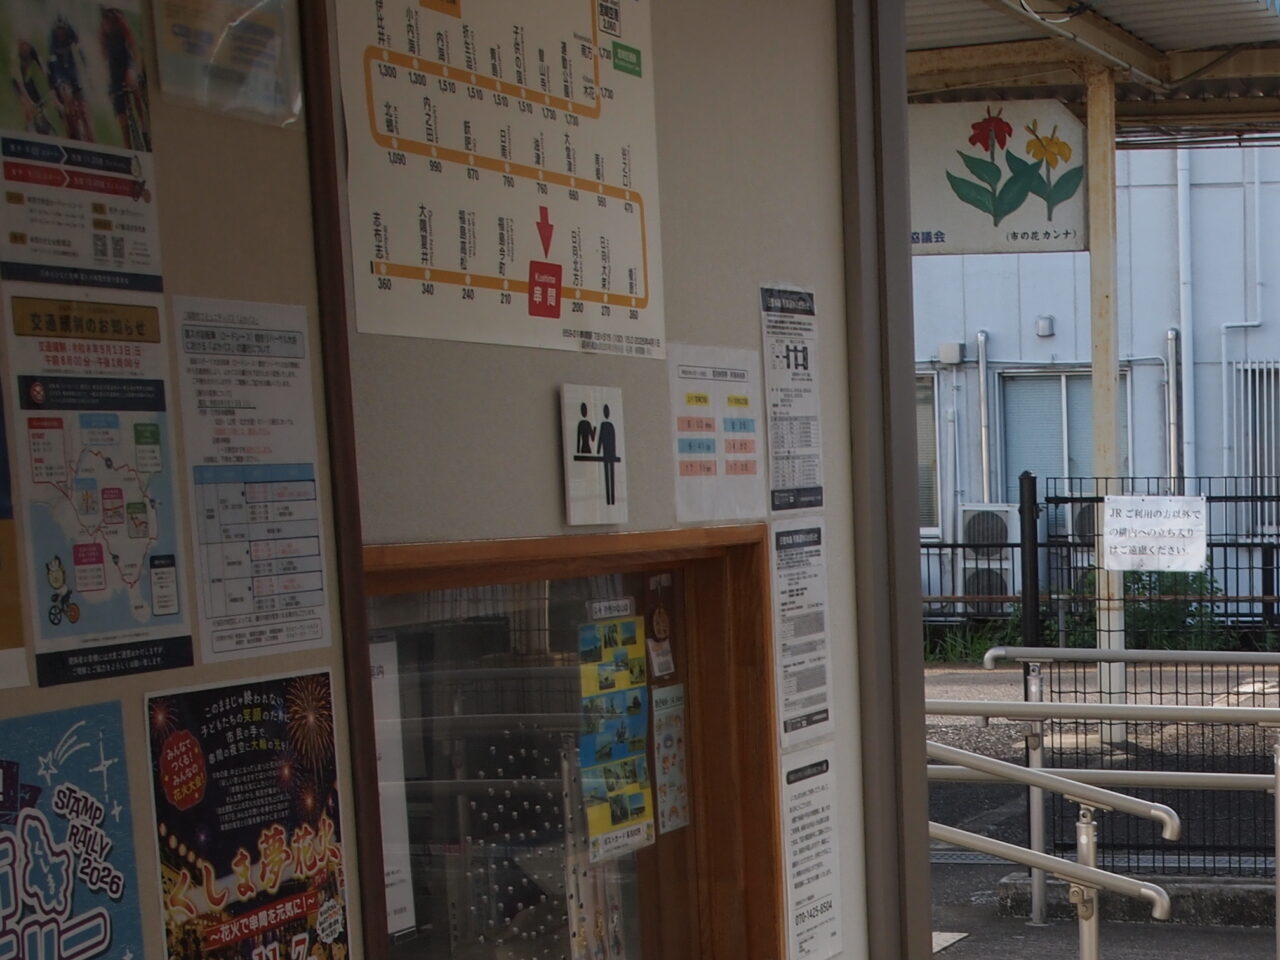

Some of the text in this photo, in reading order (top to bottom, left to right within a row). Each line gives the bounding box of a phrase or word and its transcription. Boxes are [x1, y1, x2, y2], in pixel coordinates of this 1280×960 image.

[438, 79, 456, 94] 1,510
[467, 87, 483, 101] 1,510
[378, 278, 392, 291] 360
[422, 284, 434, 296] 340
[462, 288, 475, 300] 240
[500, 293, 512, 305] 210
[1110, 508, 1122, 518] JR
[55, 787, 103, 824] STAMP
[68, 824, 109, 860] RALLY
[80, 857, 122, 895] 2026
